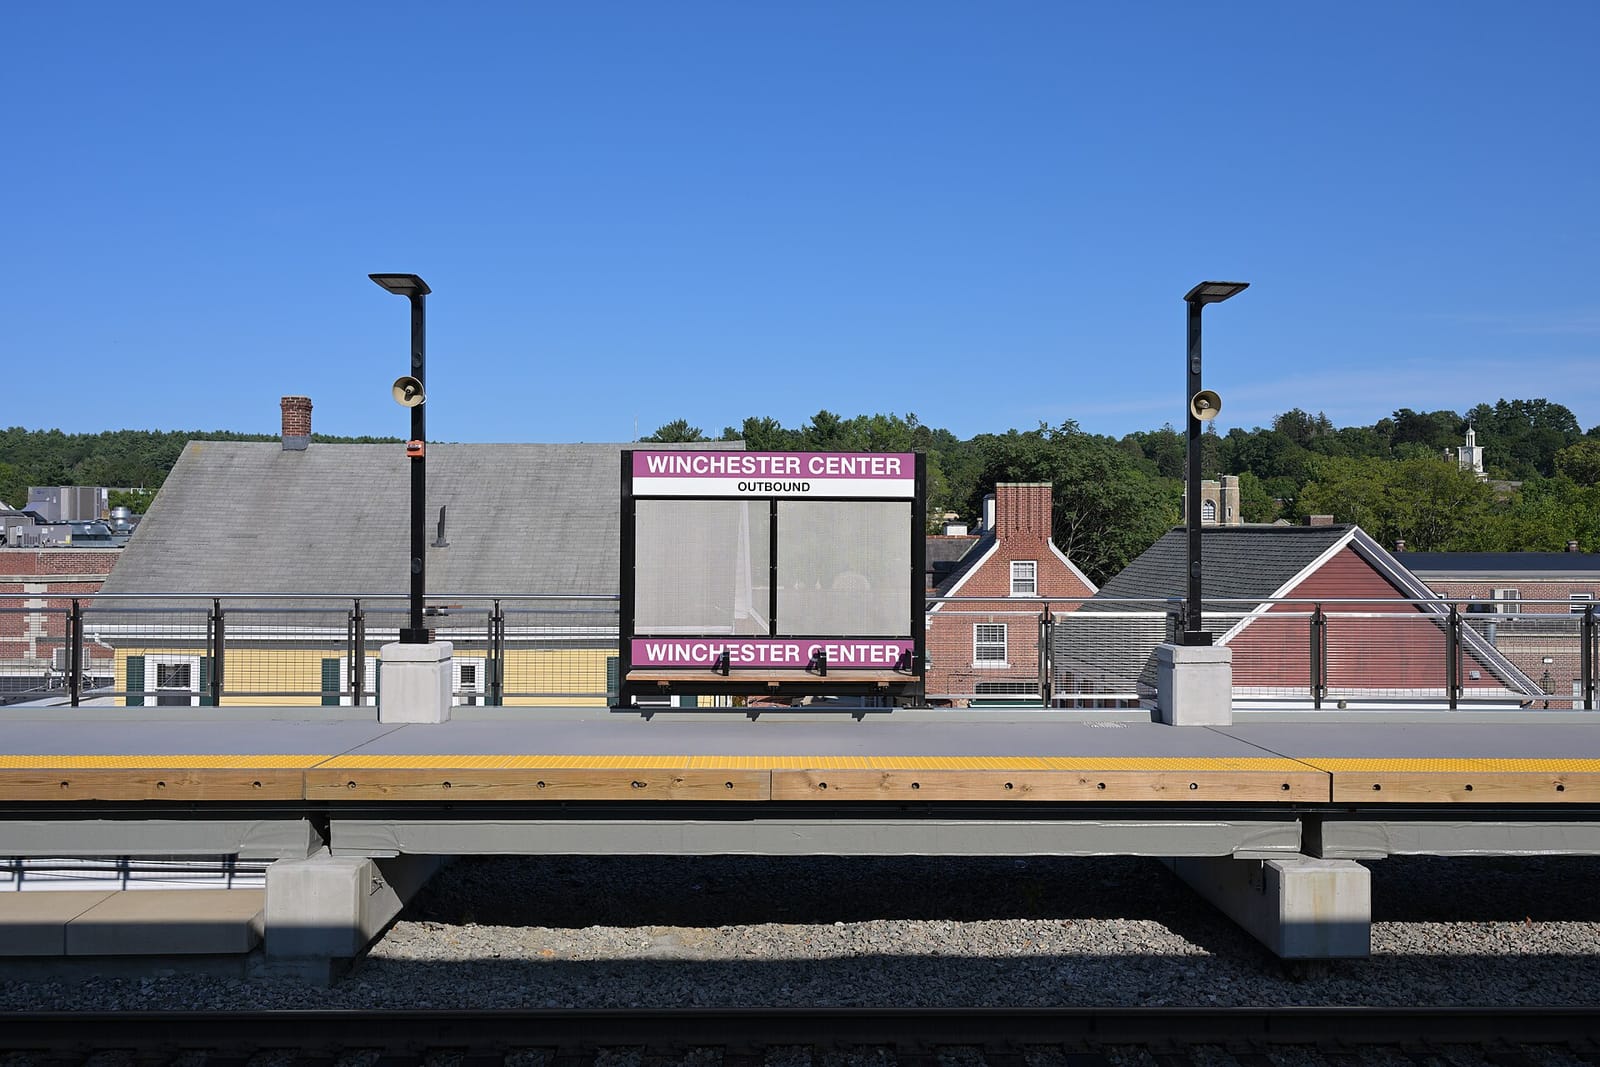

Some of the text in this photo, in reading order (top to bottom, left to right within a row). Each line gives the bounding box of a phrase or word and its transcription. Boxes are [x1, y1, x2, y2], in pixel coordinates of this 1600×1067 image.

[646, 455, 901, 475] WINCHESTER CENTER
[737, 481, 811, 492] OUTBOUND
[645, 643, 800, 662] WINCHESTER
